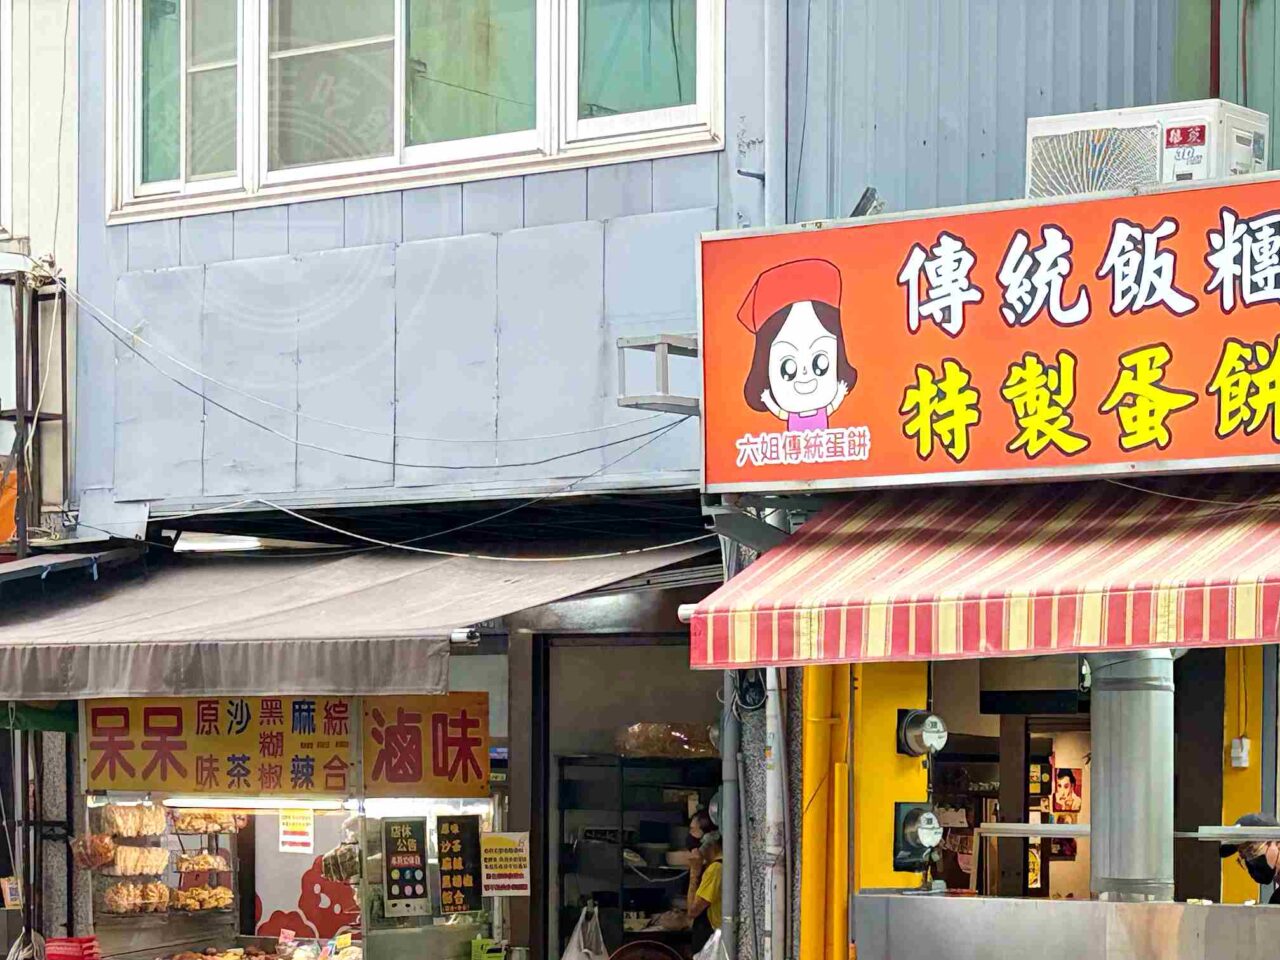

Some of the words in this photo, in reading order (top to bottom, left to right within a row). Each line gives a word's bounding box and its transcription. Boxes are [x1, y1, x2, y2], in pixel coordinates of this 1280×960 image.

[737, 427, 870, 466] 六姐傳統蛋餅
[90, 706, 189, 782] 呆呆
[195, 700, 220, 789] 原味
[226, 699, 251, 789] 沙茶
[291, 699, 316, 790] 麻辣
[323, 700, 349, 791] 綜合
[371, 706, 483, 783] 滷味
